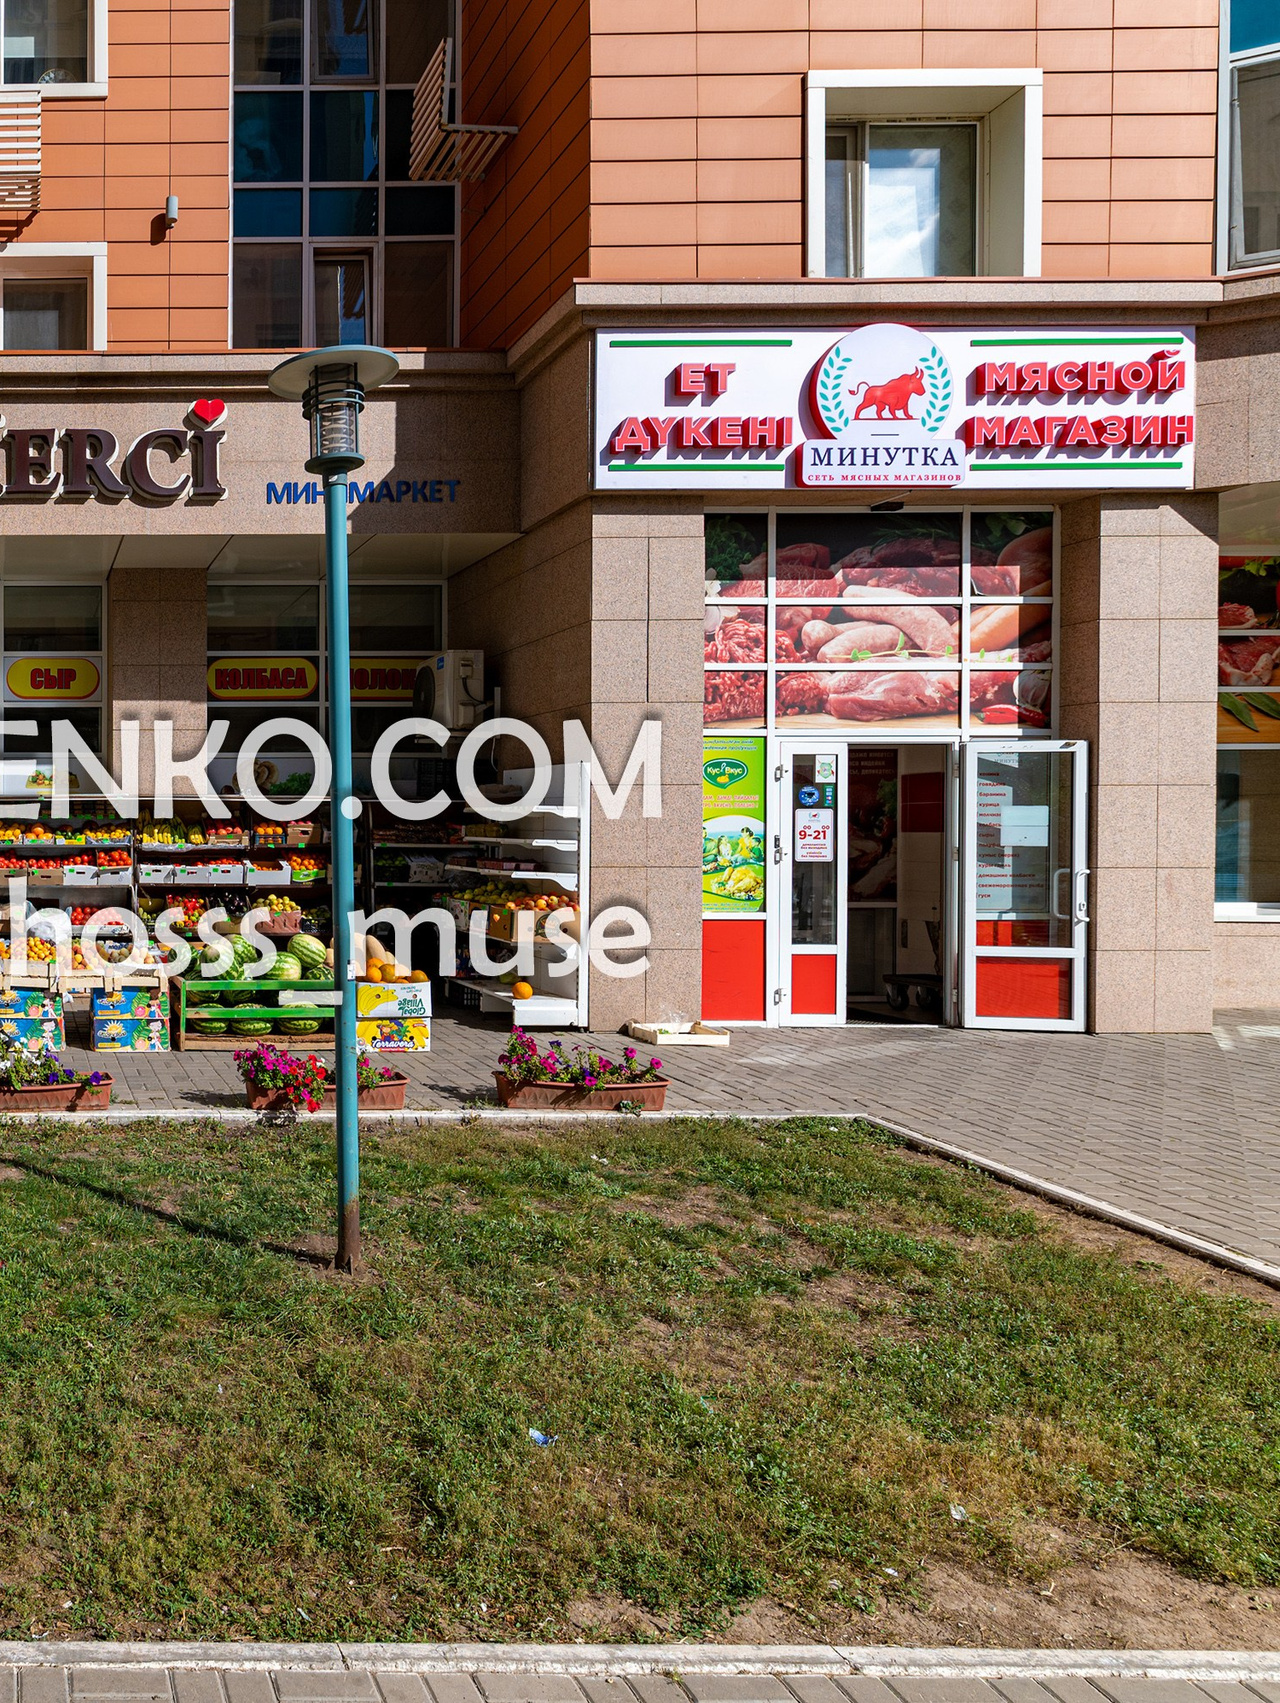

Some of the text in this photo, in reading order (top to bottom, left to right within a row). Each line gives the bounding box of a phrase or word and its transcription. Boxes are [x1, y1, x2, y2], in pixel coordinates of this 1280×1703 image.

[677, 361, 737, 394] ЕТ
[978, 349, 1187, 395] МЯСНОЙ
[967, 414, 1195, 448] МАГАЗИН
[809, 447, 960, 467] МИНУТКА
[807, 474, 962, 482] СЕТЬ МЯСНЫХ МАГАЗИНОВ
[266, 480, 461, 505] МИНМАРКЕТ
[30, 667, 77, 690] СЫР
[215, 667, 309, 690] КОЛБАСА
[350, 667, 417, 691] ОЛОК
[707, 767, 743, 776] Кус Вкус
[398, 998, 424, 1008] Village
[400, 1007, 426, 1016] Global
[371, 1039, 415, 1049] Terravera
